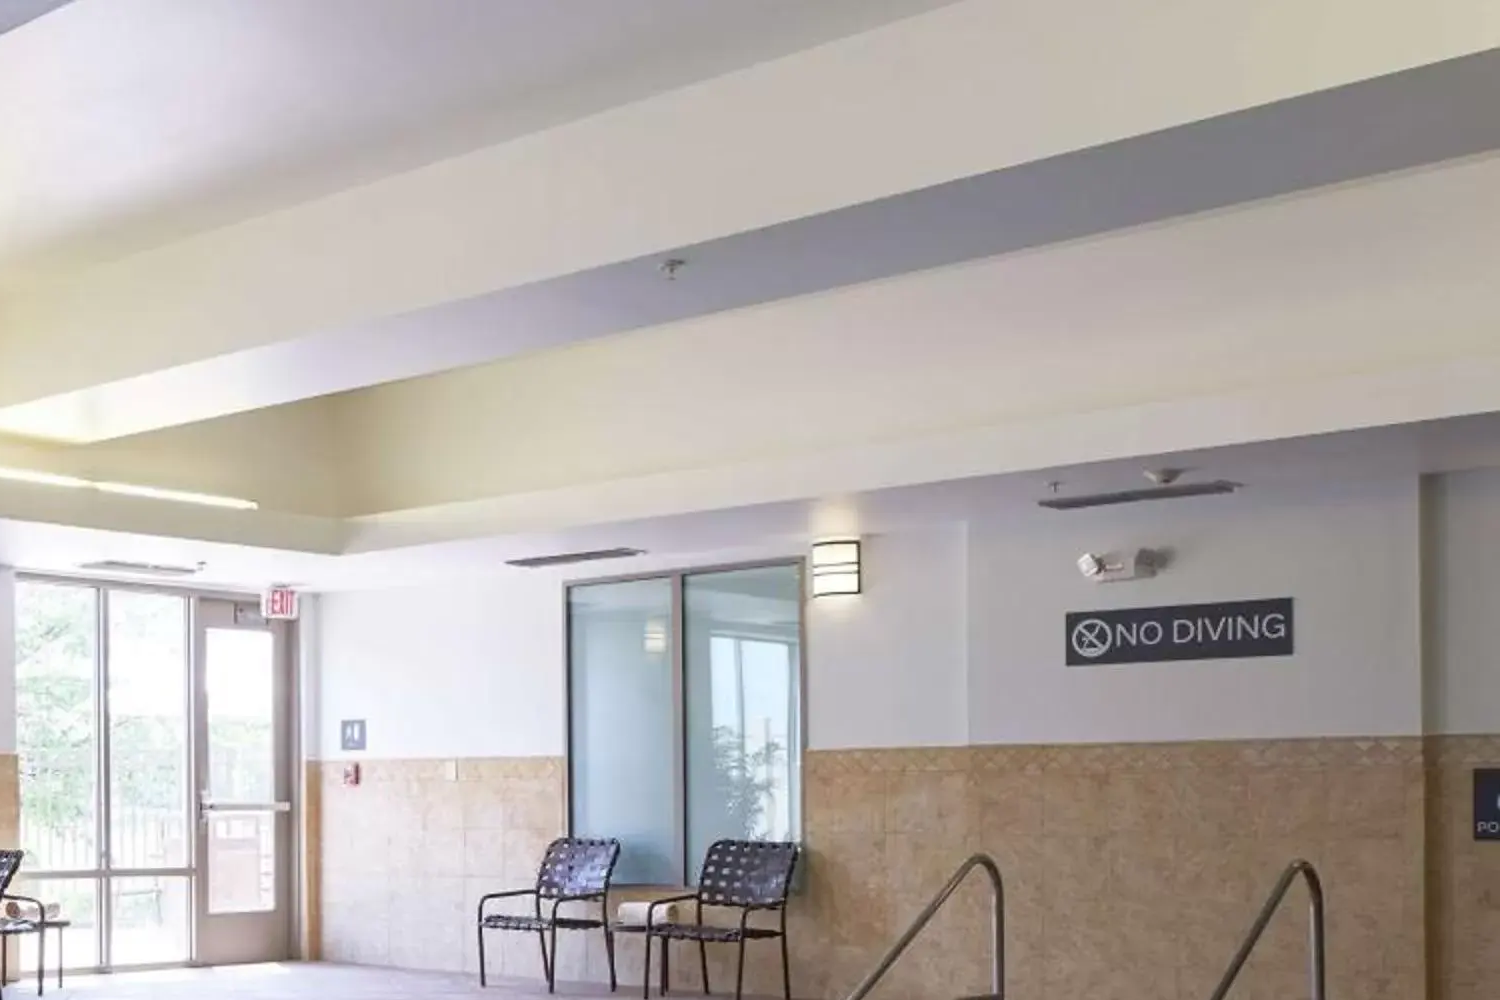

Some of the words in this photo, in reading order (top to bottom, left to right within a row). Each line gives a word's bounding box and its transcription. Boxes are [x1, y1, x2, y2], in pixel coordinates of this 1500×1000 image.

[271, 590, 294, 615] EXIT
[1115, 620, 1163, 648] NO
[1172, 613, 1286, 645] DIVING
